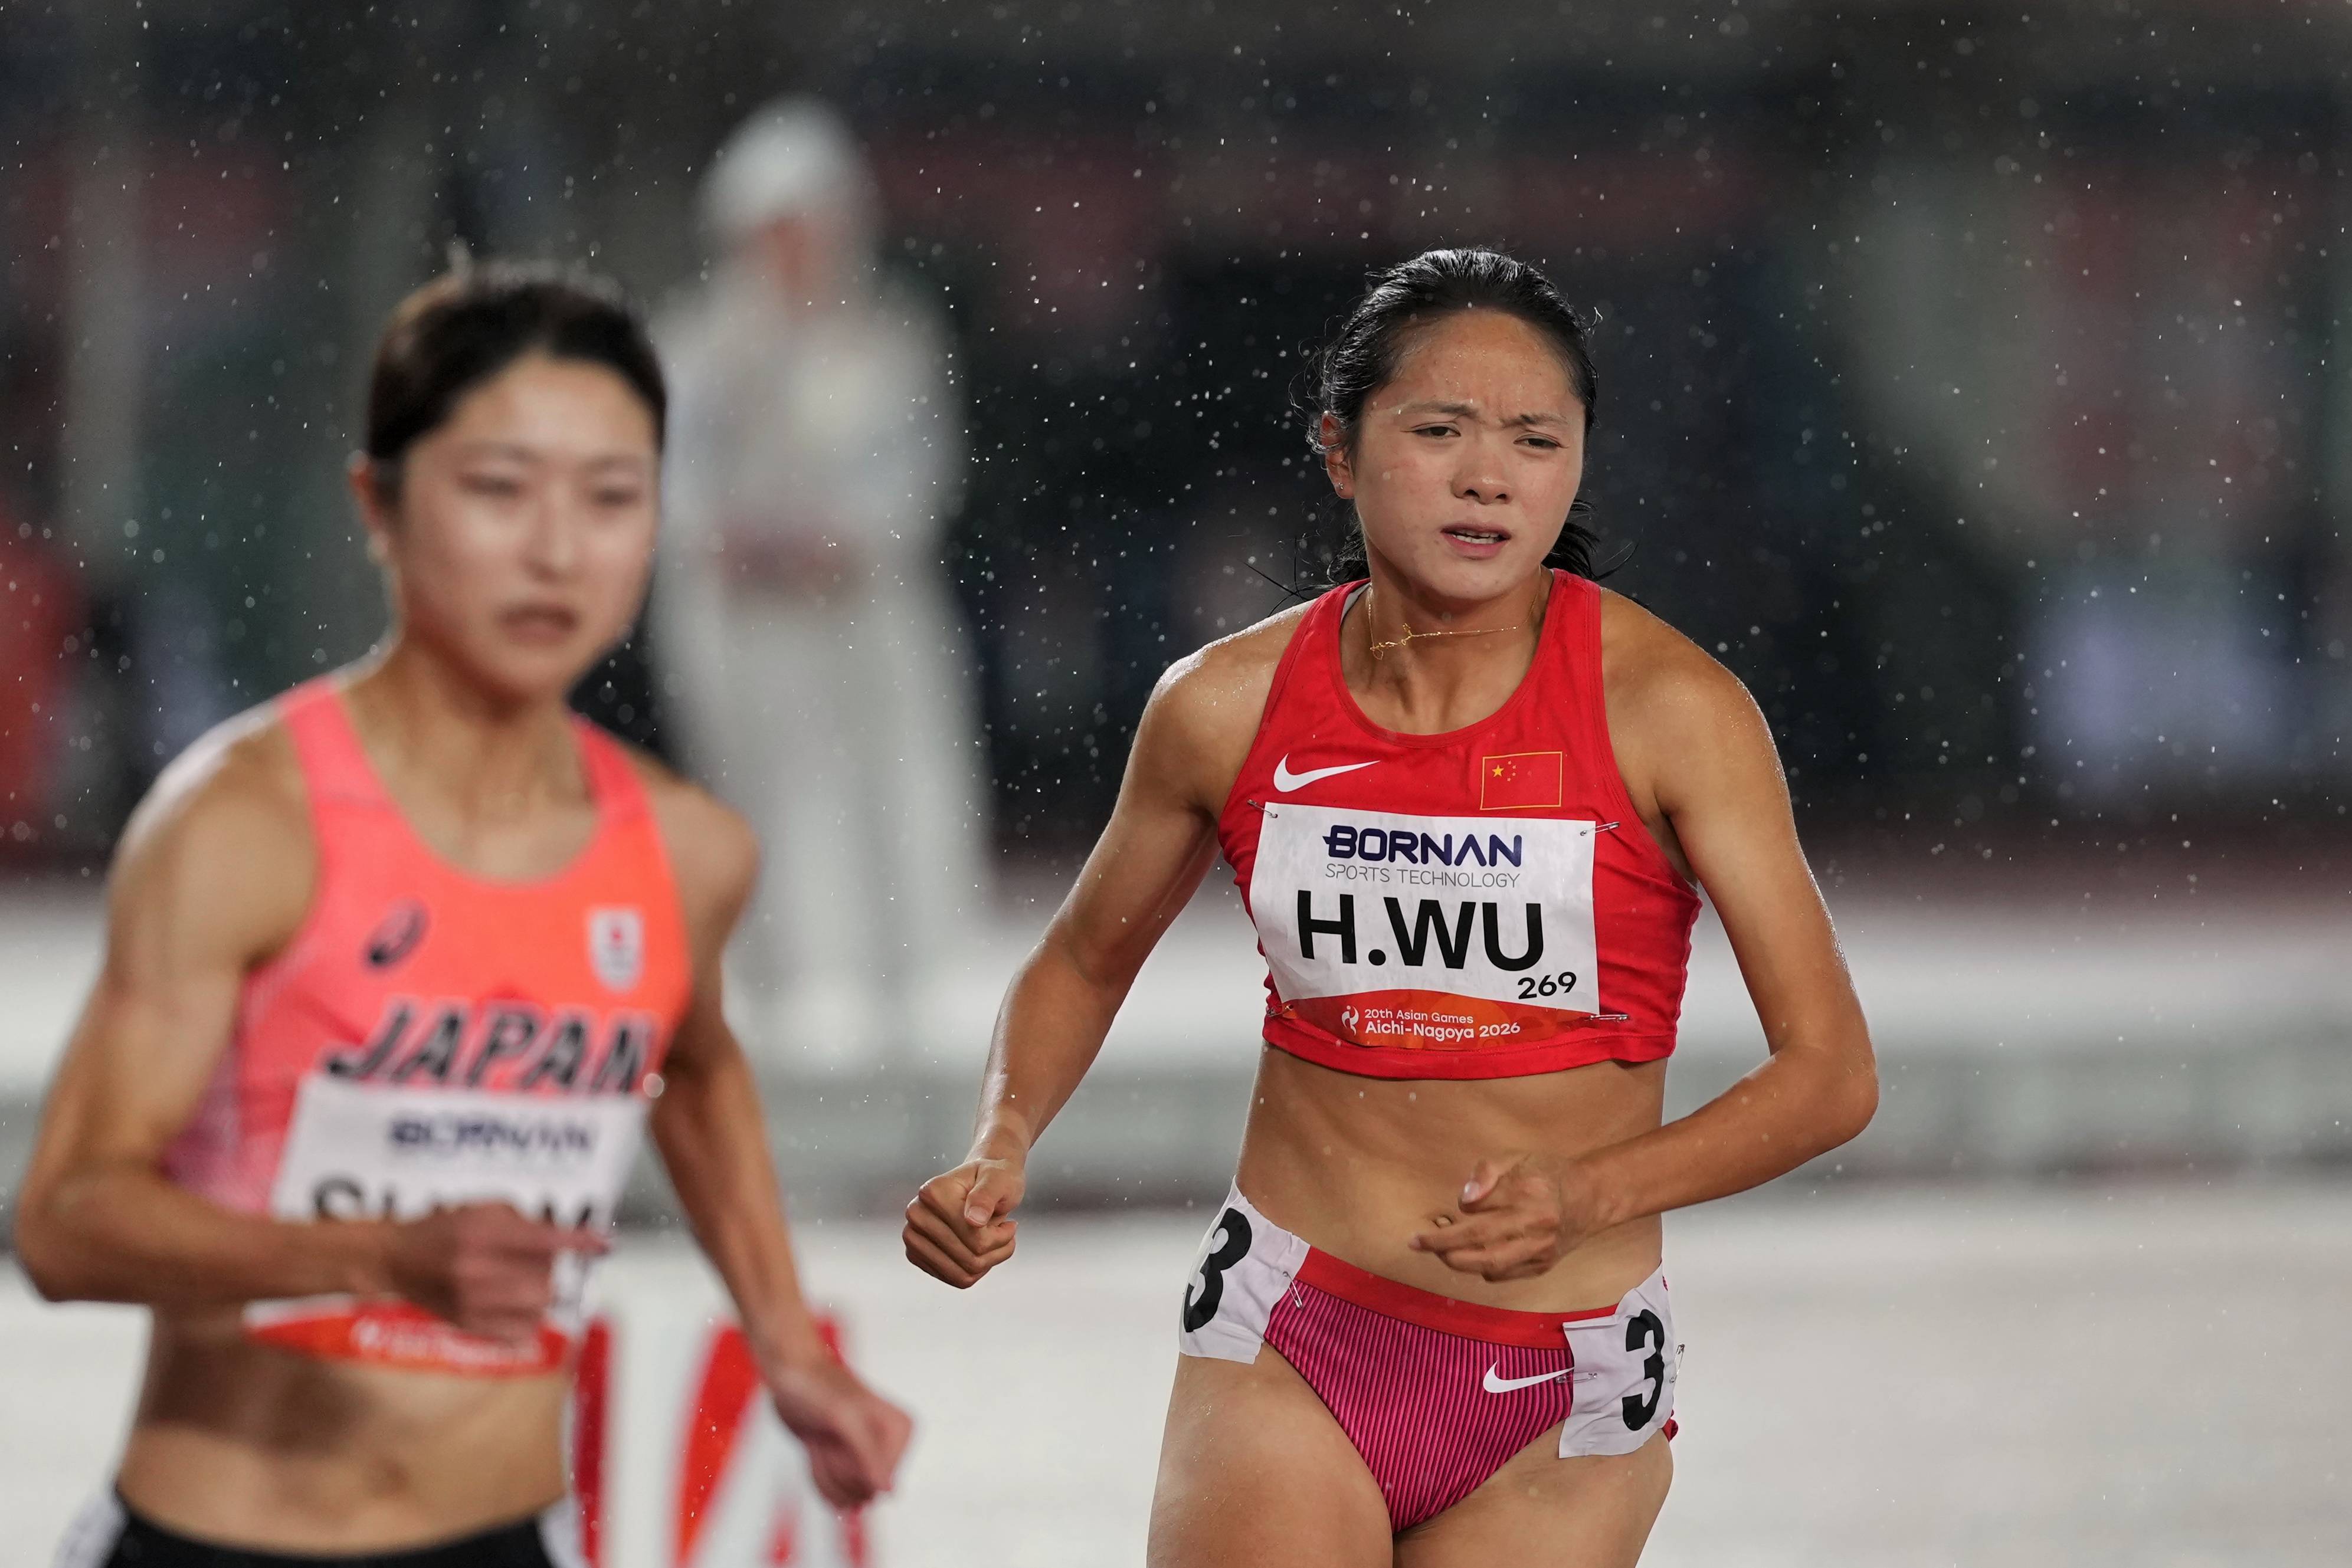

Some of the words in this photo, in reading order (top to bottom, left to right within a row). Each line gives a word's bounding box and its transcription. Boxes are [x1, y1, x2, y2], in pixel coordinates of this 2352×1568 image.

[1322, 825, 1522, 867] BORNAN
[1325, 864, 1390, 883] SPORTS
[1397, 869, 1521, 888] TECHNOLOGY
[1297, 890, 1544, 972] H.WU
[1517, 972, 1577, 999] 269
[1364, 1009, 1393, 1020] 20th
[1396, 1011, 1429, 1022] Asian
[1431, 1012, 1474, 1024] Games
[1365, 1021, 1475, 1042] Aichi-Nagoya
[1479, 1022, 1521, 1038] 2026
[323, 1006, 656, 1093] JAPAN
[1184, 1208, 1252, 1333] 3
[1622, 1308, 1665, 1431] 3
